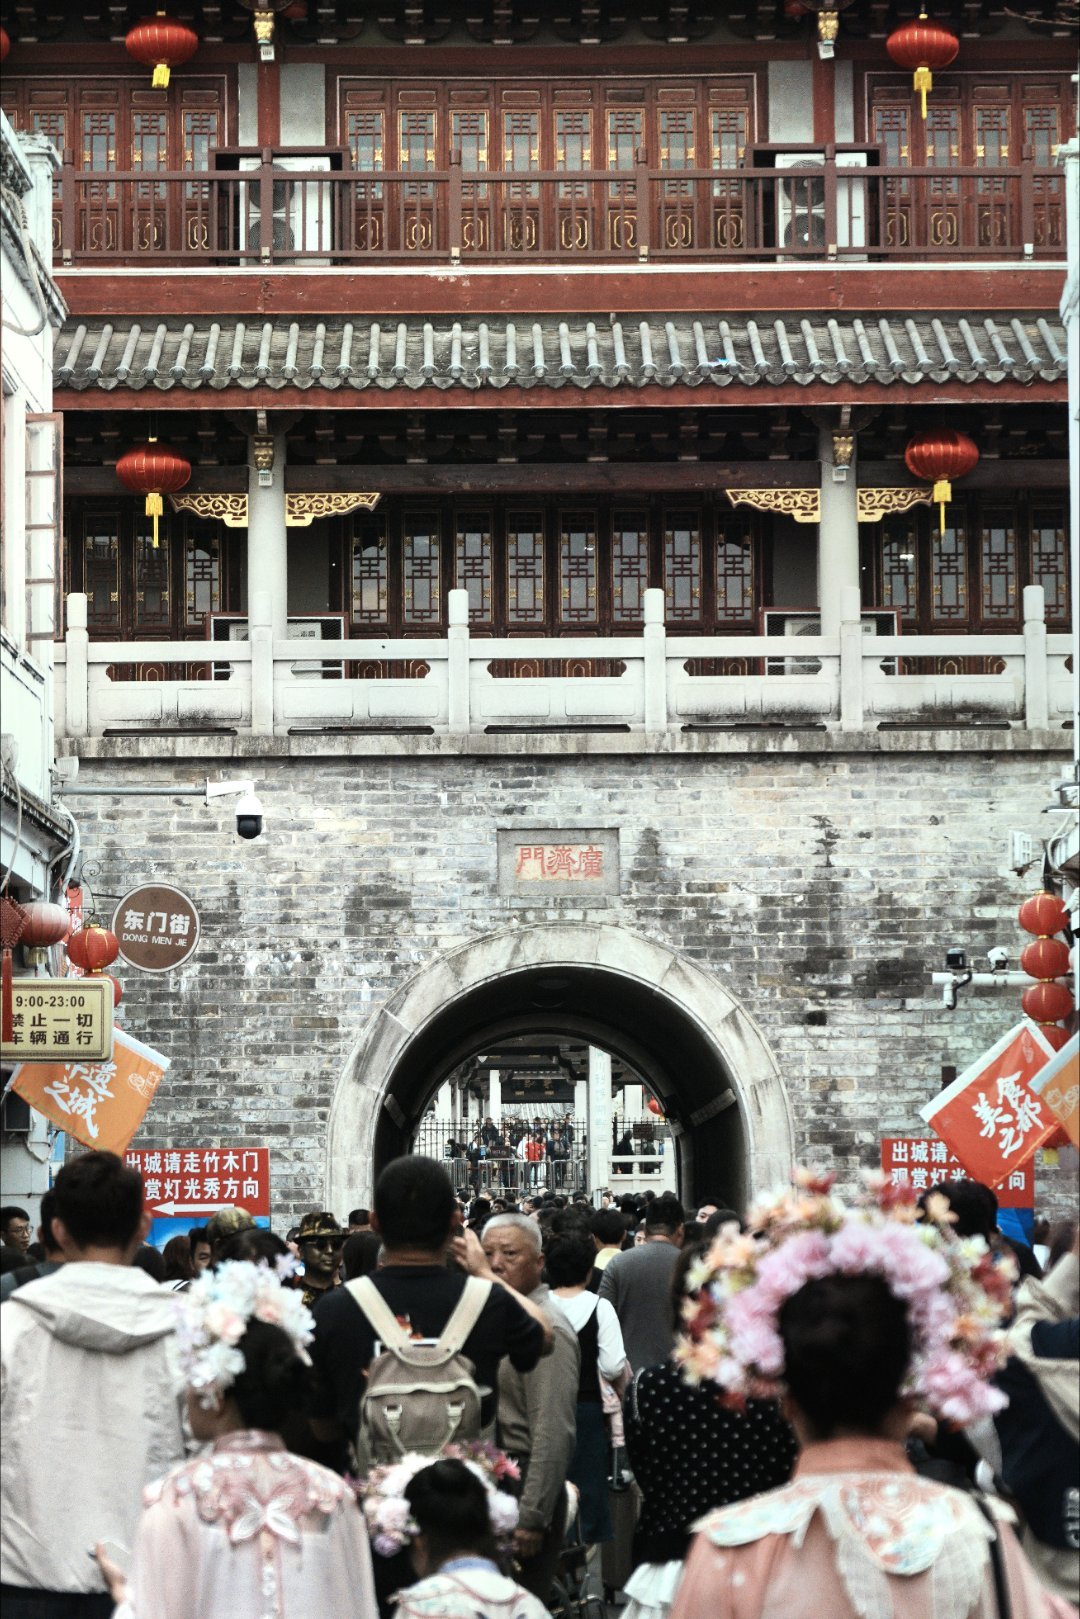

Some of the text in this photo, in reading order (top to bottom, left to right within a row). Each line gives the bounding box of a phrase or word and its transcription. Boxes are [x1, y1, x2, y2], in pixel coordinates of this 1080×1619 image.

[123, 909, 190, 935] 东门街
[122, 933, 188, 947] DONG MEN JIE
[16, 996, 85, 1007] 9:00-23:00
[126, 1151, 258, 1173] 出城请走竹木门
[892, 1141, 960, 1163] 出城请
